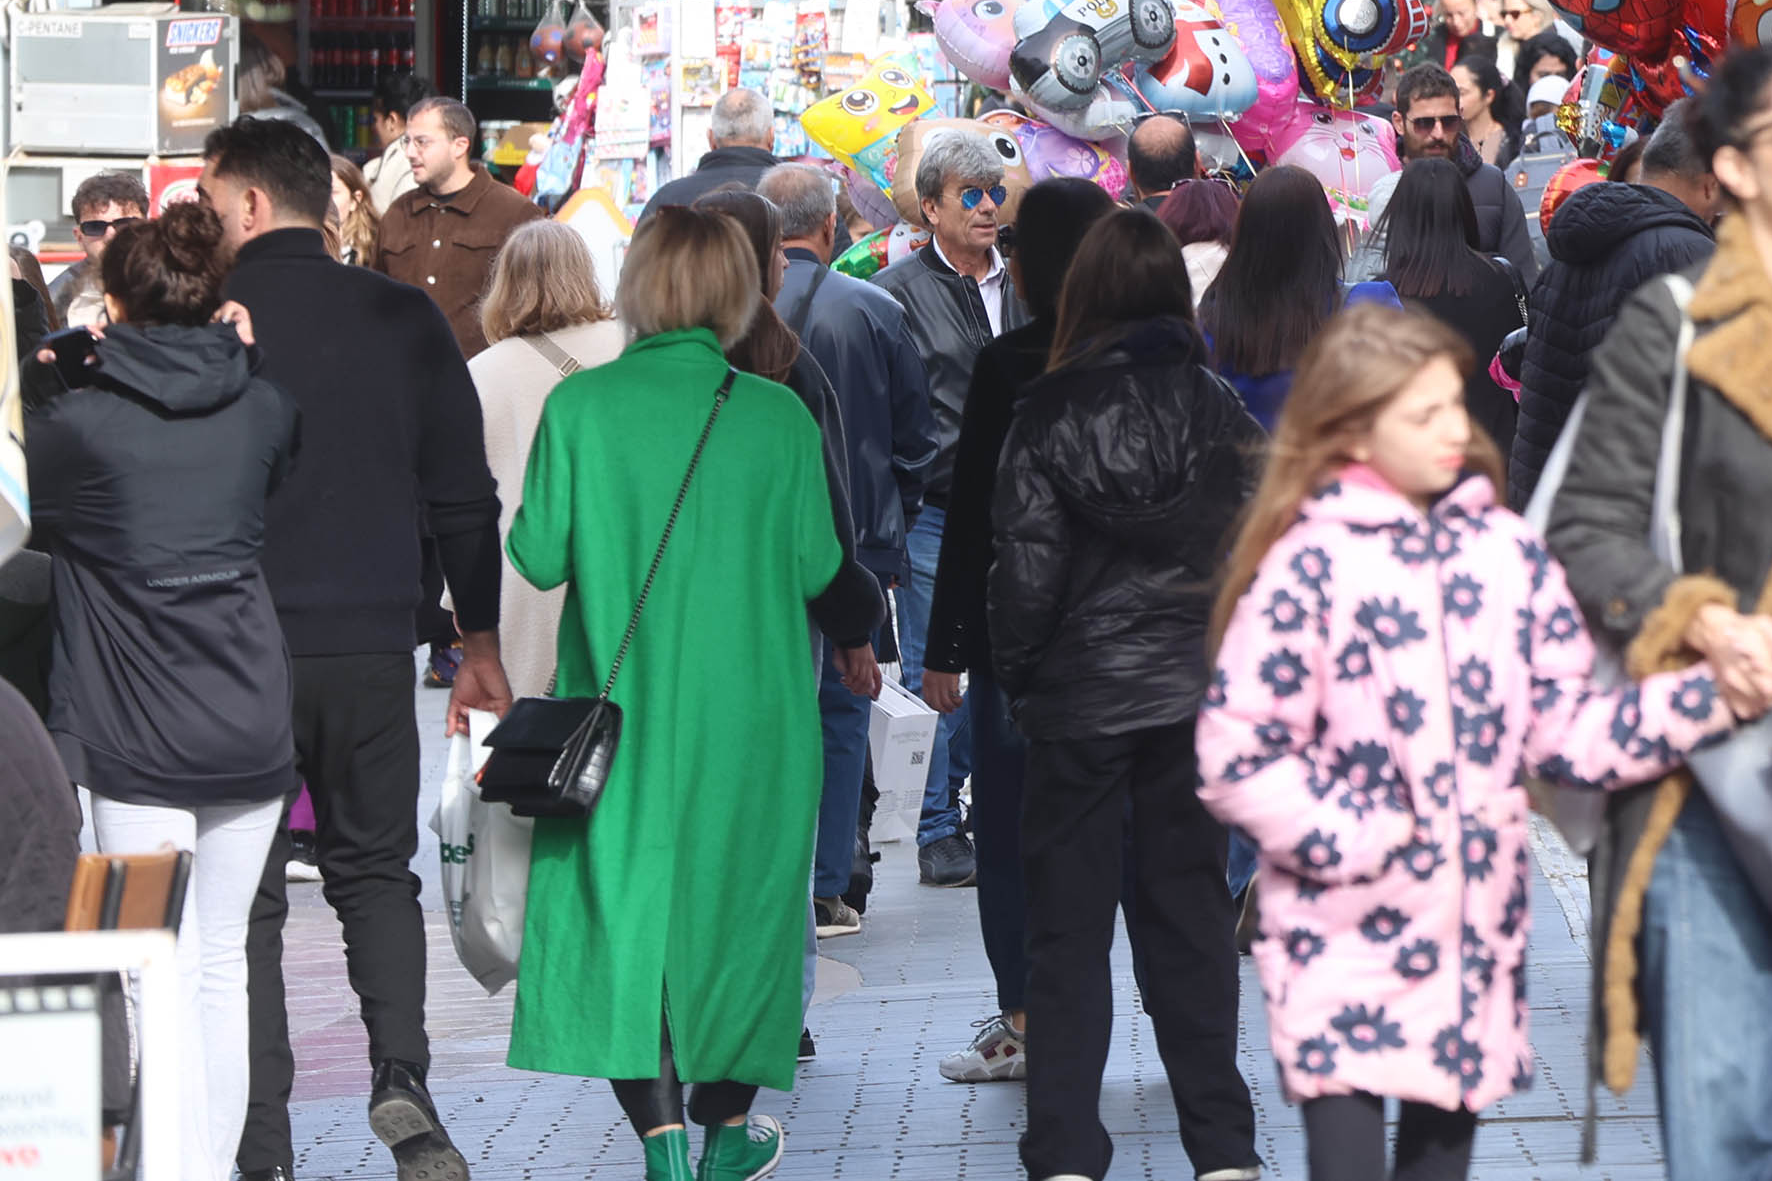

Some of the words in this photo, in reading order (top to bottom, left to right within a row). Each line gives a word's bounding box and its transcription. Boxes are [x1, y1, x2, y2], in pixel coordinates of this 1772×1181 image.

[169, 21, 220, 44] SNICKERS
[146, 577, 189, 588] UNDER
[191, 570, 240, 583] ARMOUR
